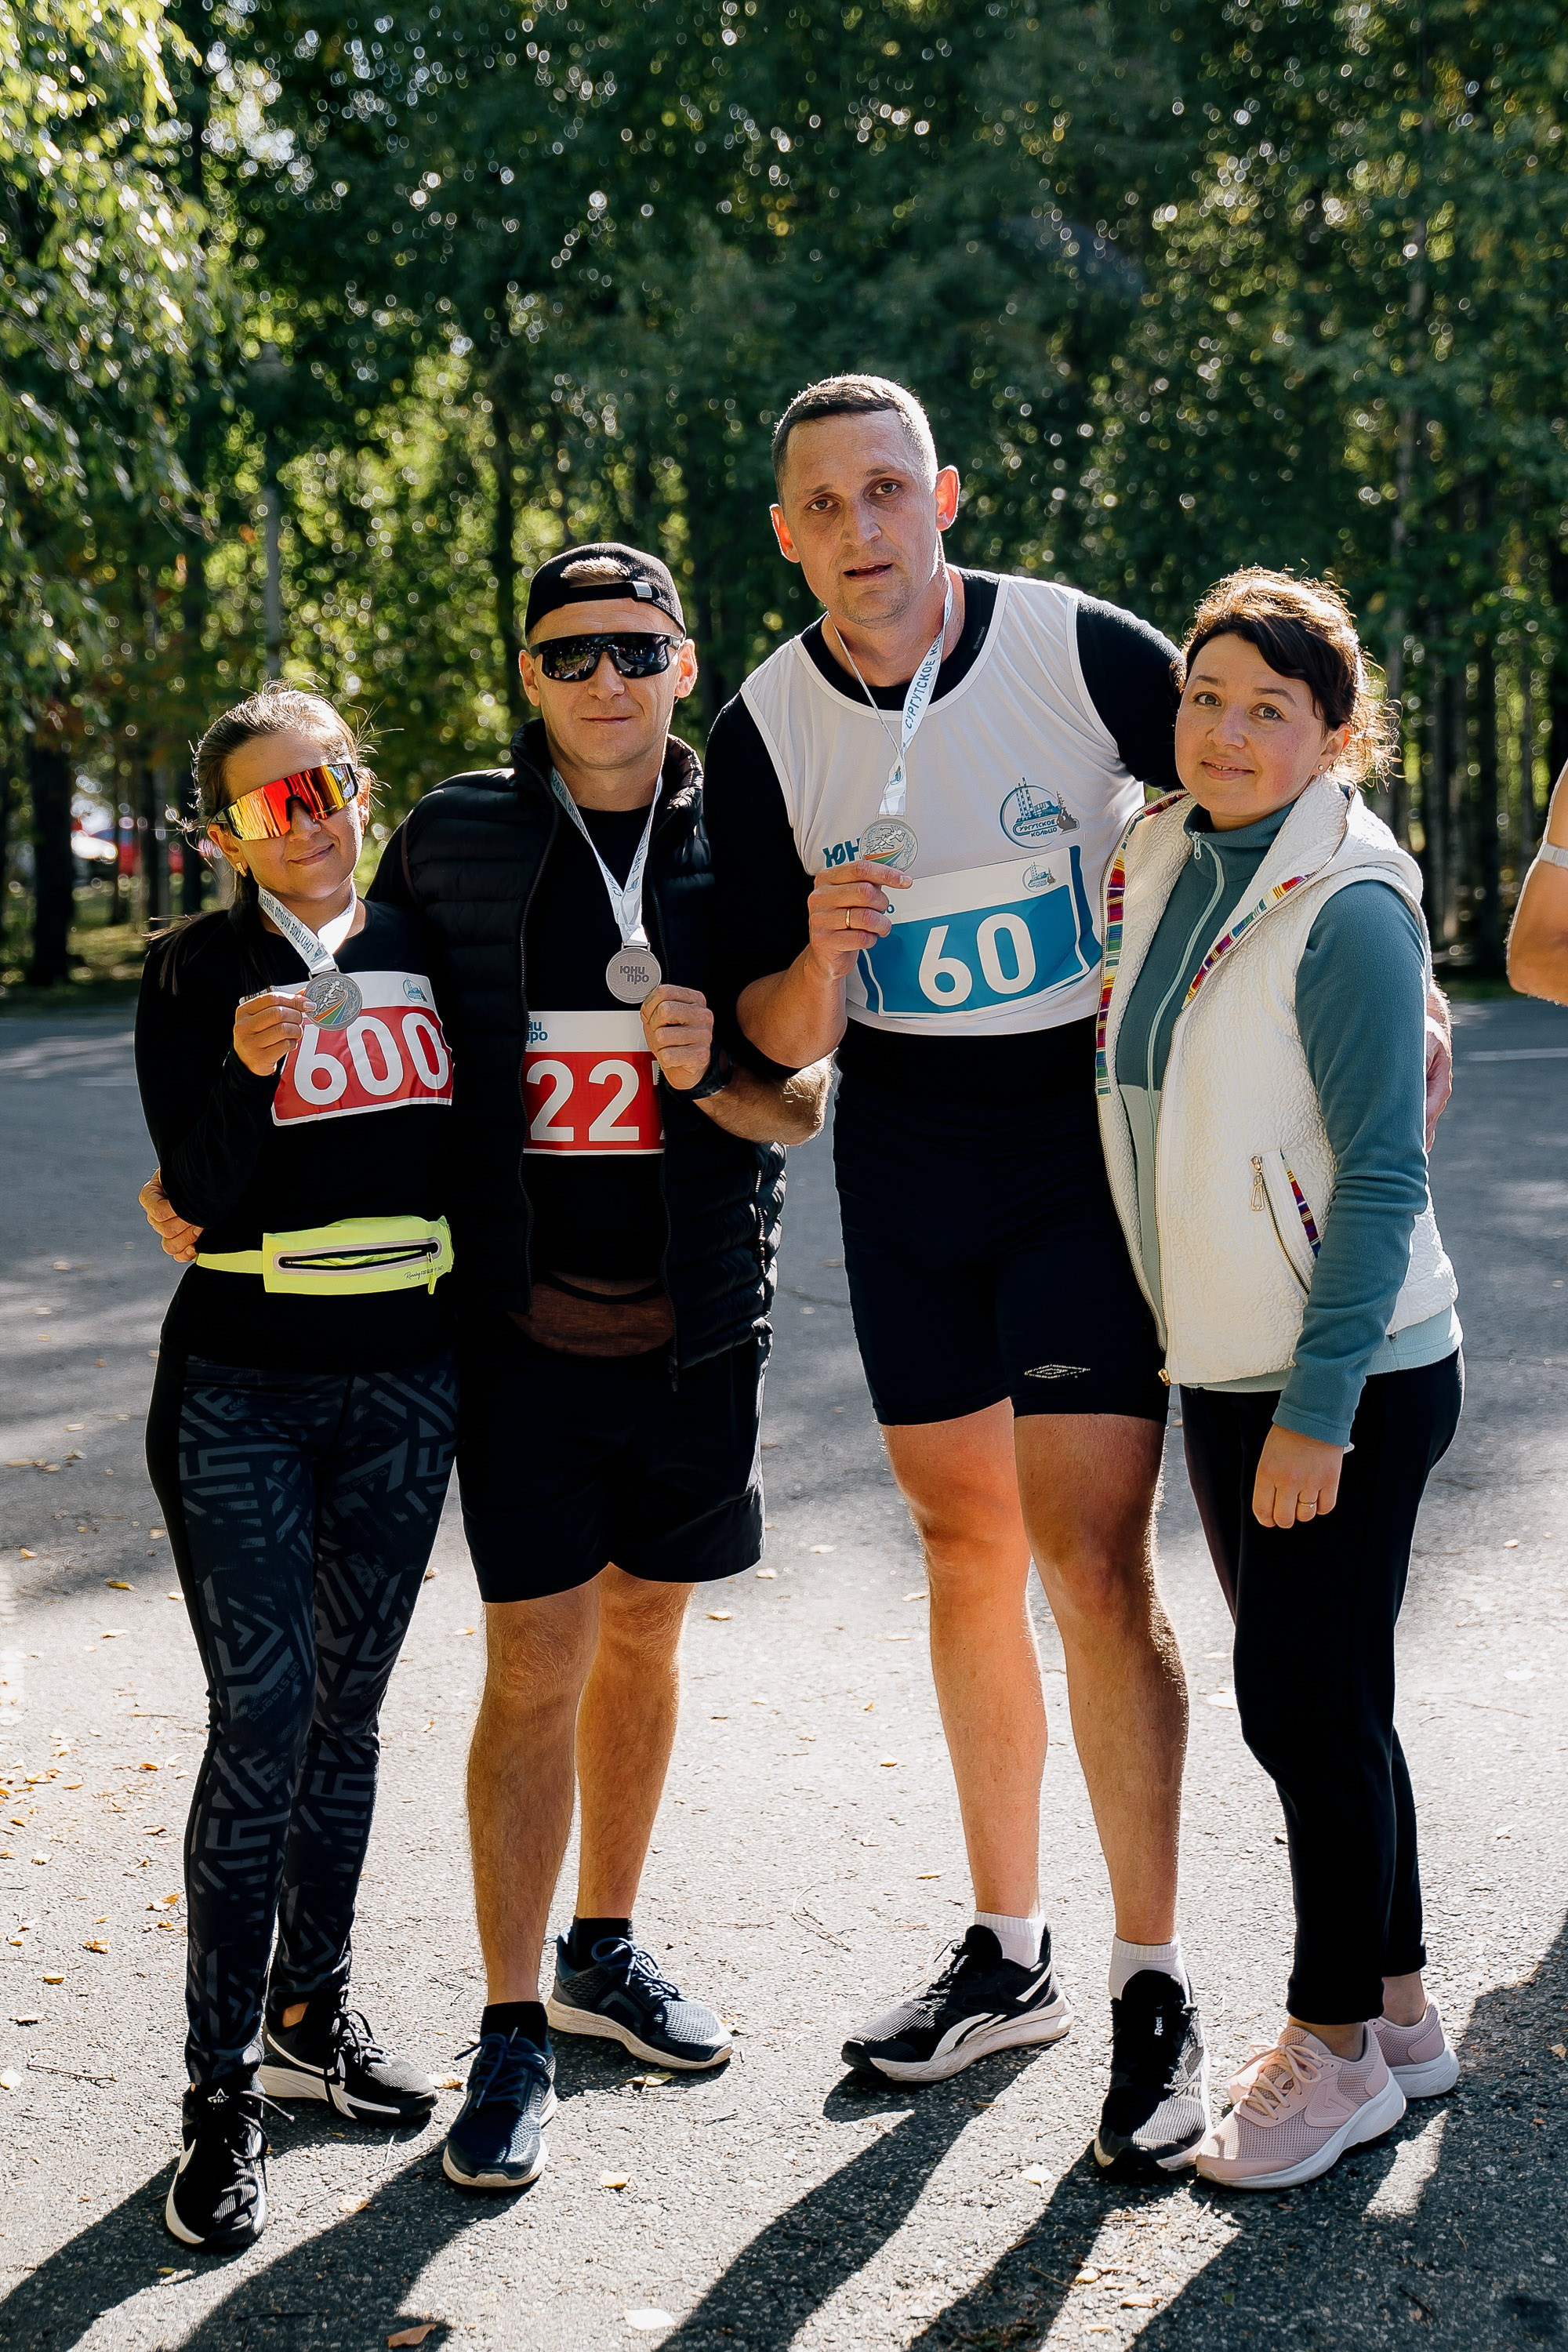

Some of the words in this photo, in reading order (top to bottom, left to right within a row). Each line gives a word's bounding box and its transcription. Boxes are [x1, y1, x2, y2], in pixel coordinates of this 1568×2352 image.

[905, 659, 936, 729] СУРГУТСКОЕ
[1031, 827, 1058, 837] КОЛЬЦО
[918, 913, 1036, 1007] 60
[294, 1012, 449, 1105] 600
[526, 1059, 664, 1142] 22
